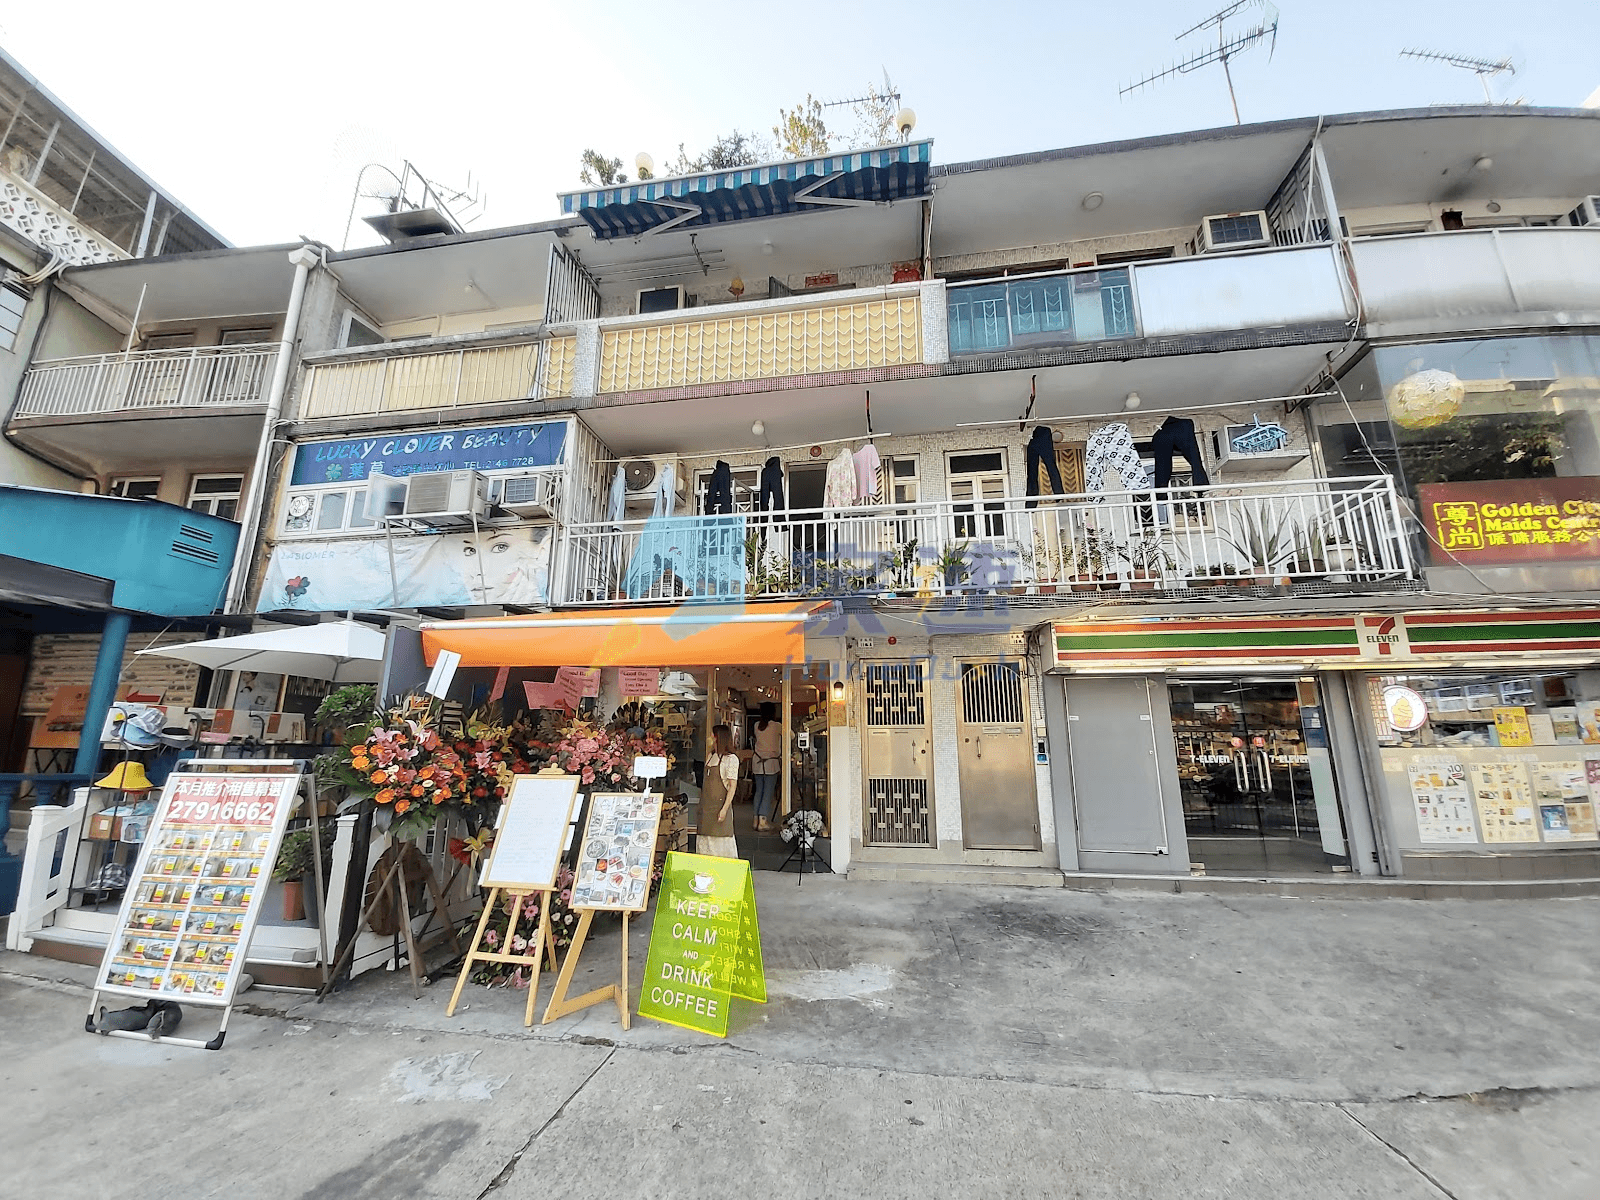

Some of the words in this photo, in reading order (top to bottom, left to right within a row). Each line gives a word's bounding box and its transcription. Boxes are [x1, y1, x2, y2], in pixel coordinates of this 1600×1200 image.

[316, 440, 377, 462] LUCKY
[381, 435, 454, 456] CLOVER
[462, 426, 543, 449] BEAUTY
[512, 456, 534, 467] 7728
[1480, 502, 1559, 517] Golden
[1441, 505, 1481, 547] 尊尚
[1484, 517, 1543, 532] Maids
[175, 780, 283, 797] 本月推介租售精選
[167, 800, 274, 821] 27916662
[676, 898, 720, 919] KEEP
[672, 922, 717, 946] CALM
[682, 949, 699, 960] AND
[661, 962, 714, 989] DRINK
[651, 986, 718, 1018] COFFEE
